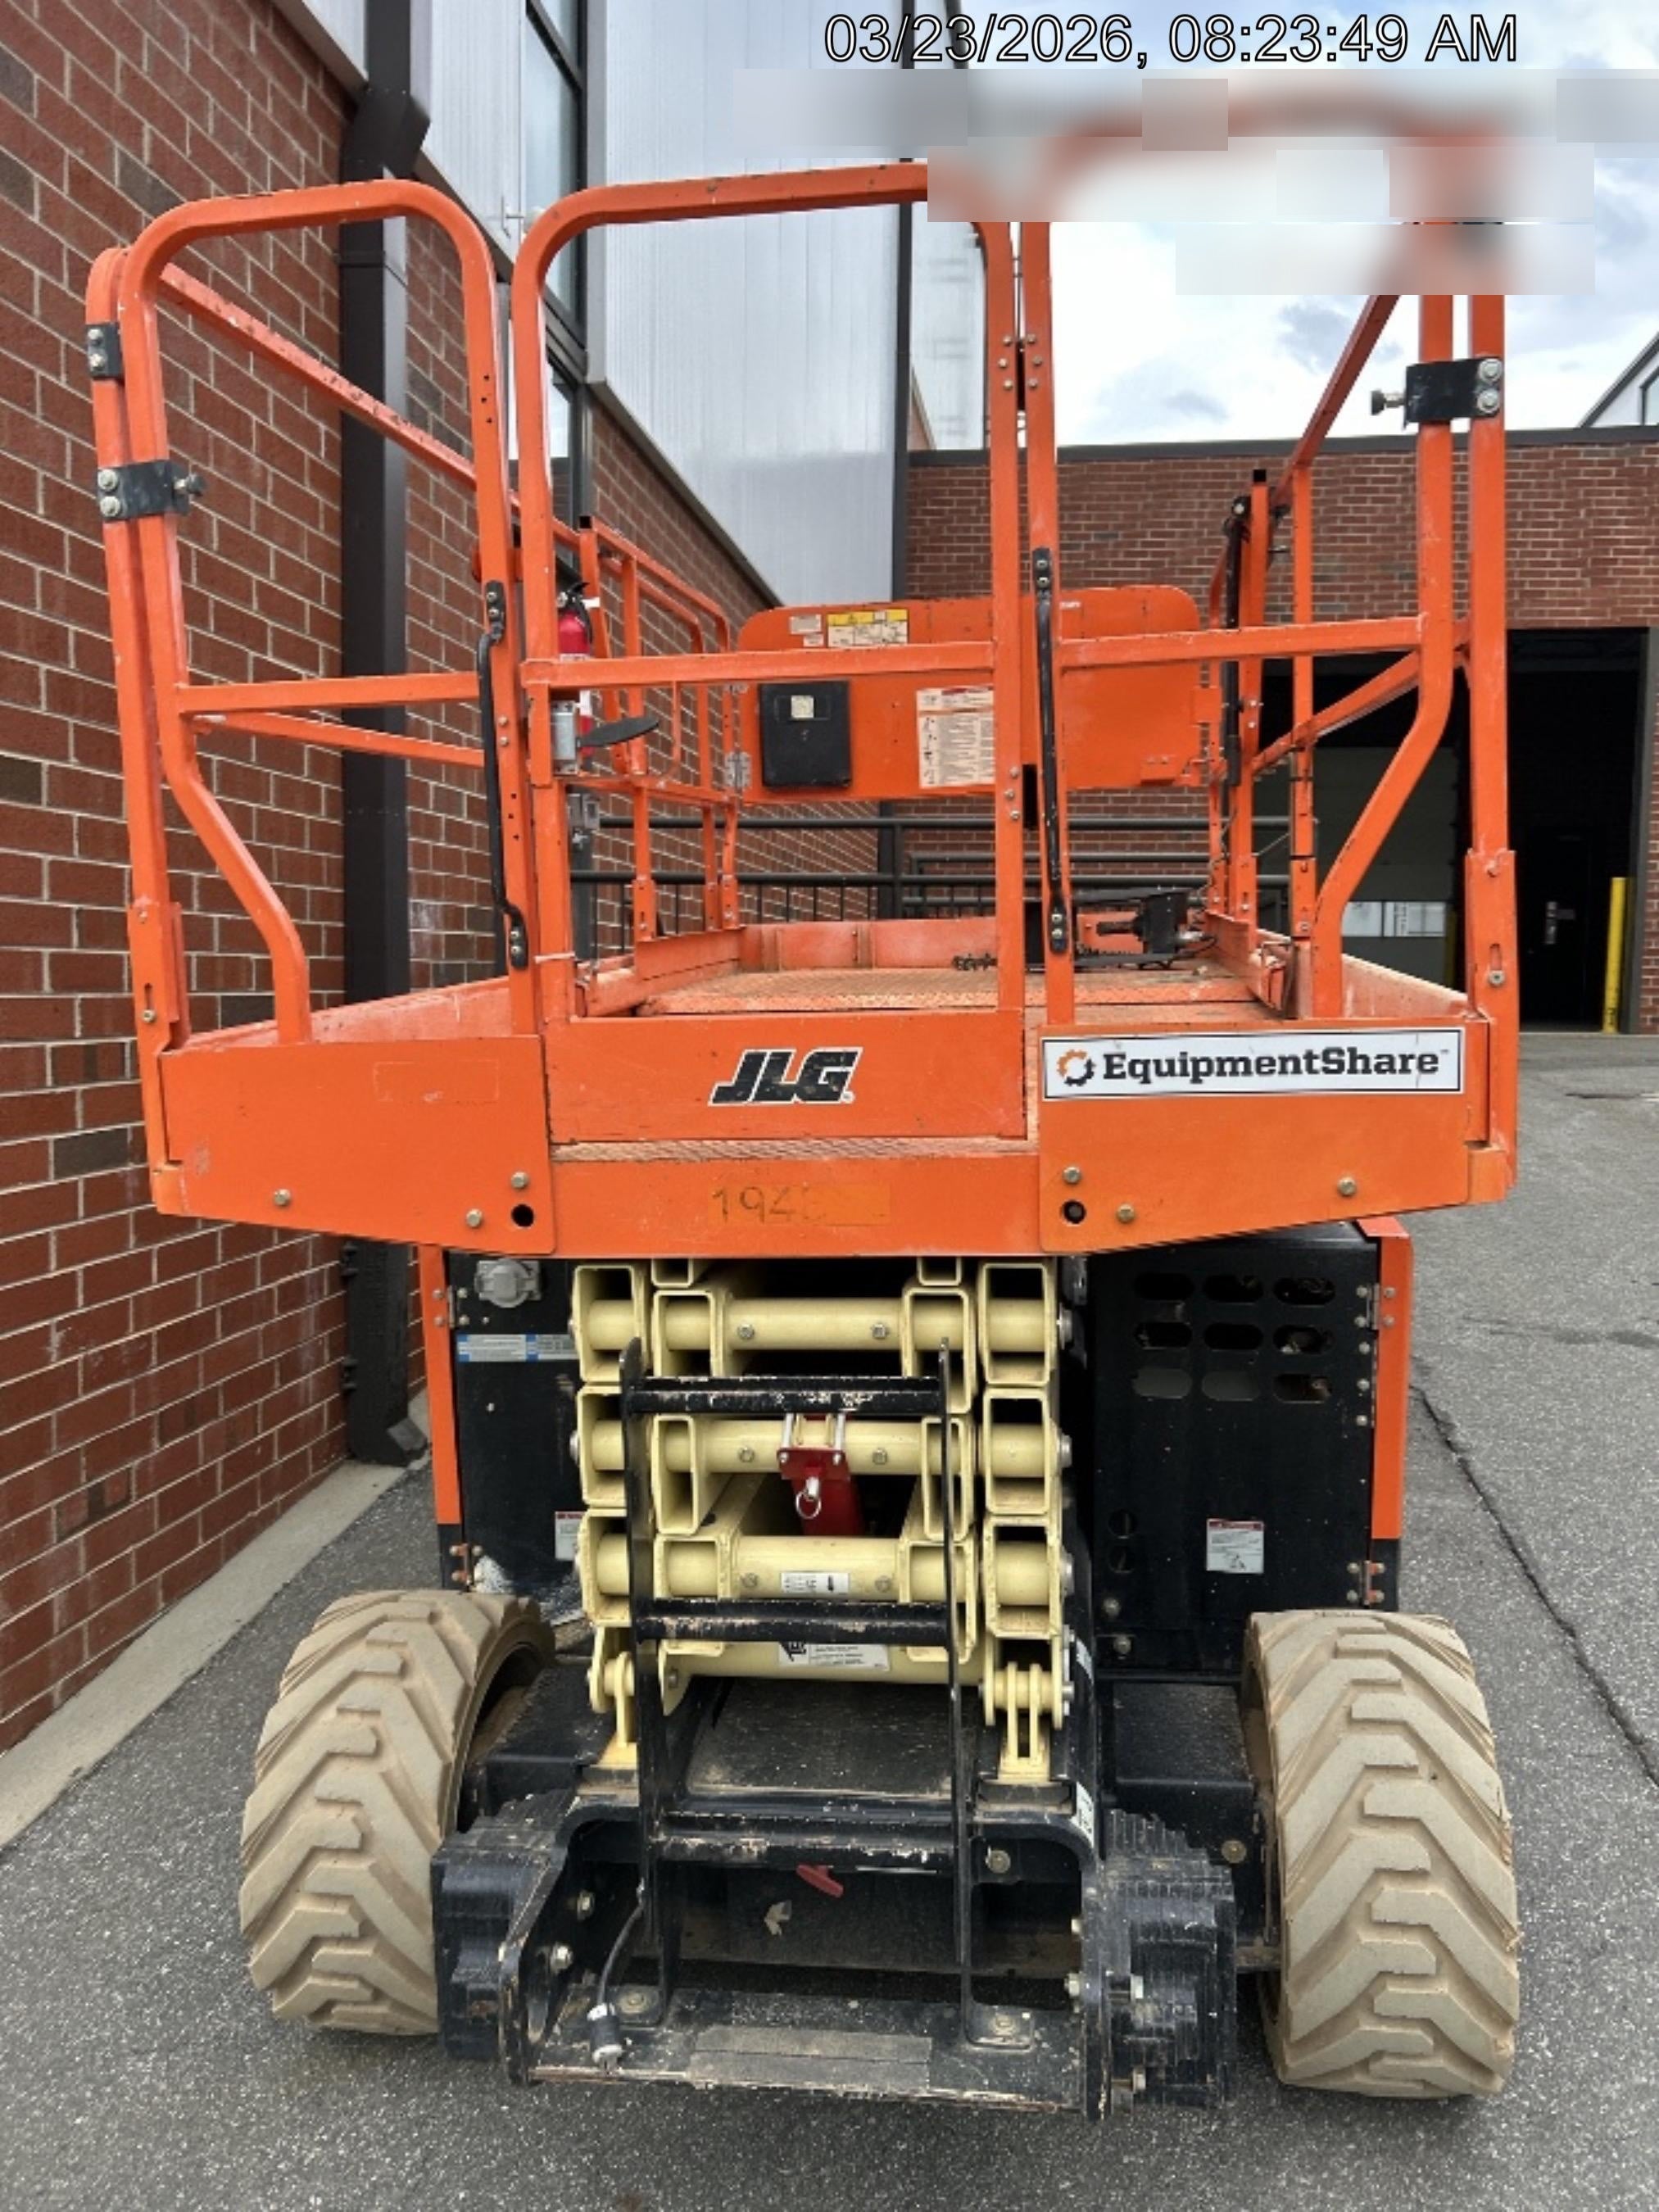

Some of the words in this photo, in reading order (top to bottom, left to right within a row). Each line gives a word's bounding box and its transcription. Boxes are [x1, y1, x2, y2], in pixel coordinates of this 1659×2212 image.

[708, 1046, 863, 1106] JLG
[1103, 1047, 1439, 1085] EquipmentShare
[711, 1185, 826, 1224] 194
